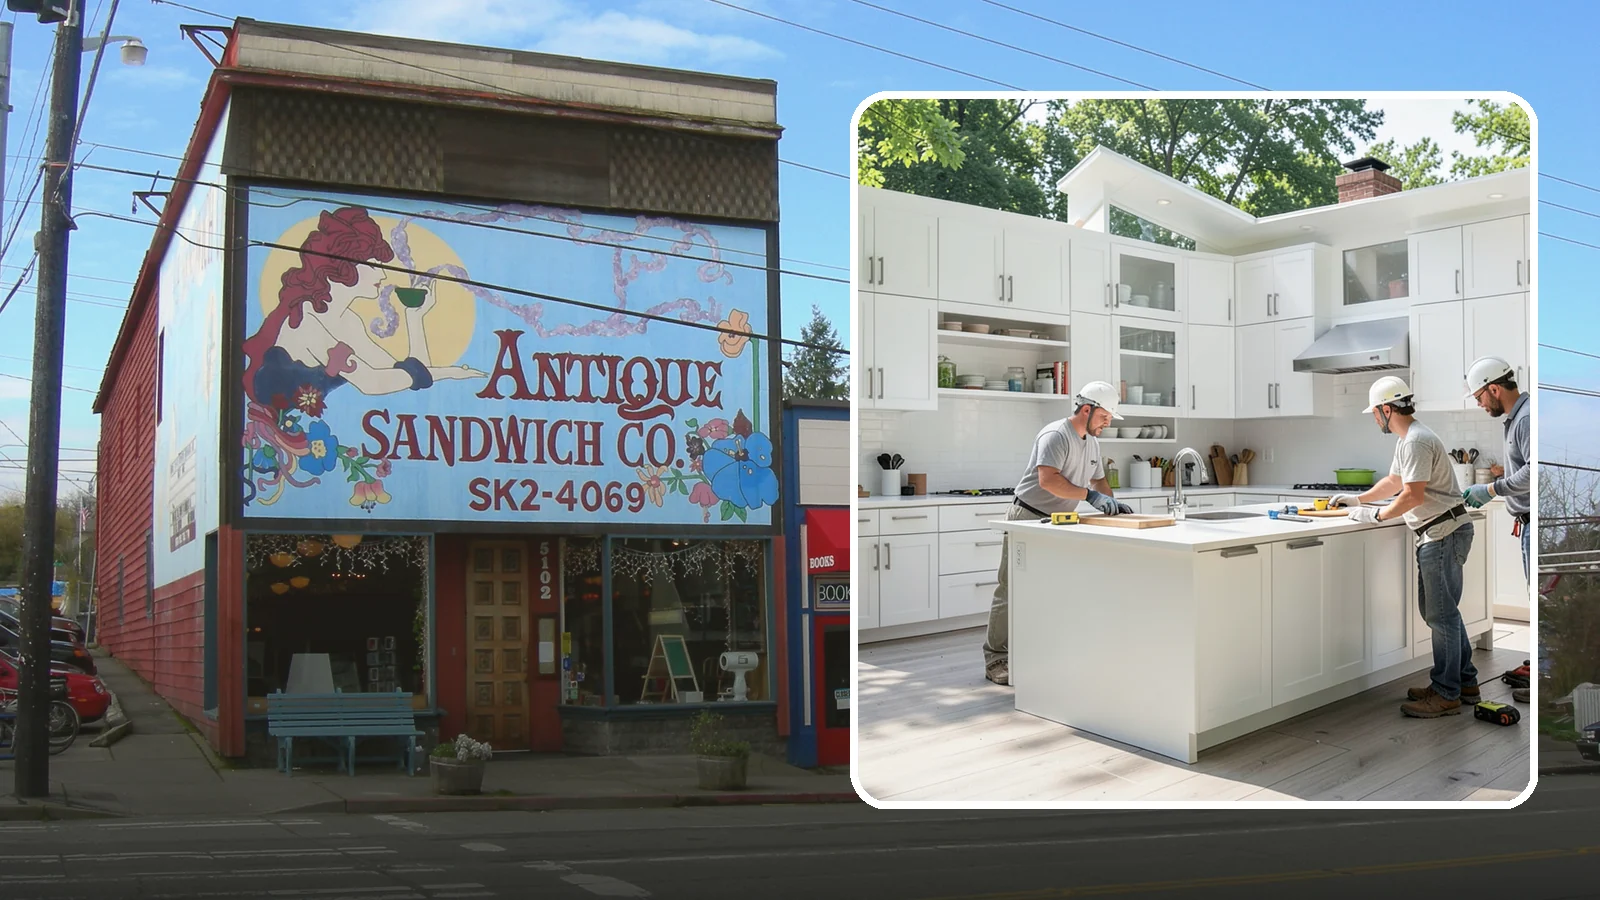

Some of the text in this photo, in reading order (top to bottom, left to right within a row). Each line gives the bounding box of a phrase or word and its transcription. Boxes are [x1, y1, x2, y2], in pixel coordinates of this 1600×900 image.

[475, 329, 723, 421] ANTIQUE
[361, 408, 685, 470] SANDWICH CO.
[468, 477, 646, 513] SK2-4069
[540, 542, 552, 599] 5102
[809, 555, 835, 569] BOOKS
